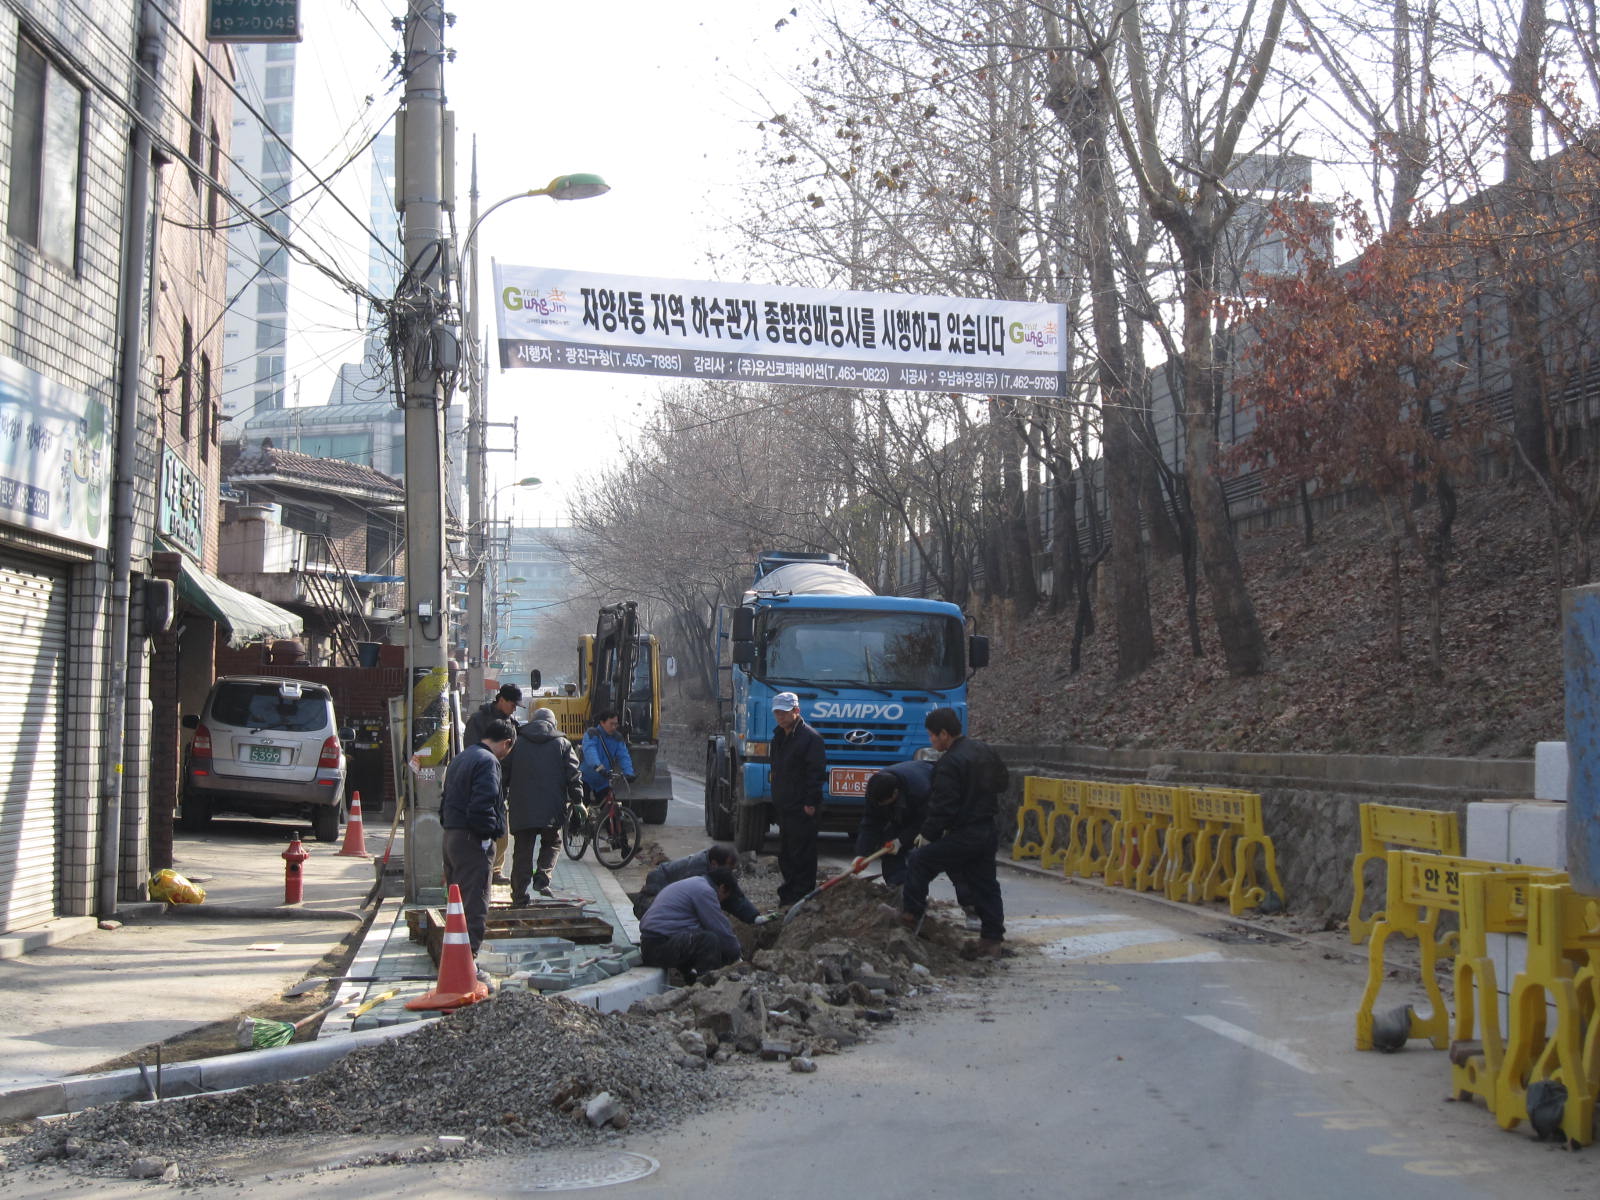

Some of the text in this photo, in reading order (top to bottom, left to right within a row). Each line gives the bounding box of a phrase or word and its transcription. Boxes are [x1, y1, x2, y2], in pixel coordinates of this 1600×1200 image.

[580, 287, 1005, 356] 자양4동 지역 하수관거 종합정비공사를 시행하고 있습니다
[517, 345, 552, 362] 시행자
[693, 356, 725, 373] 감리사
[899, 368, 928, 386] 시공사
[810, 701, 904, 720] SAMPYO
